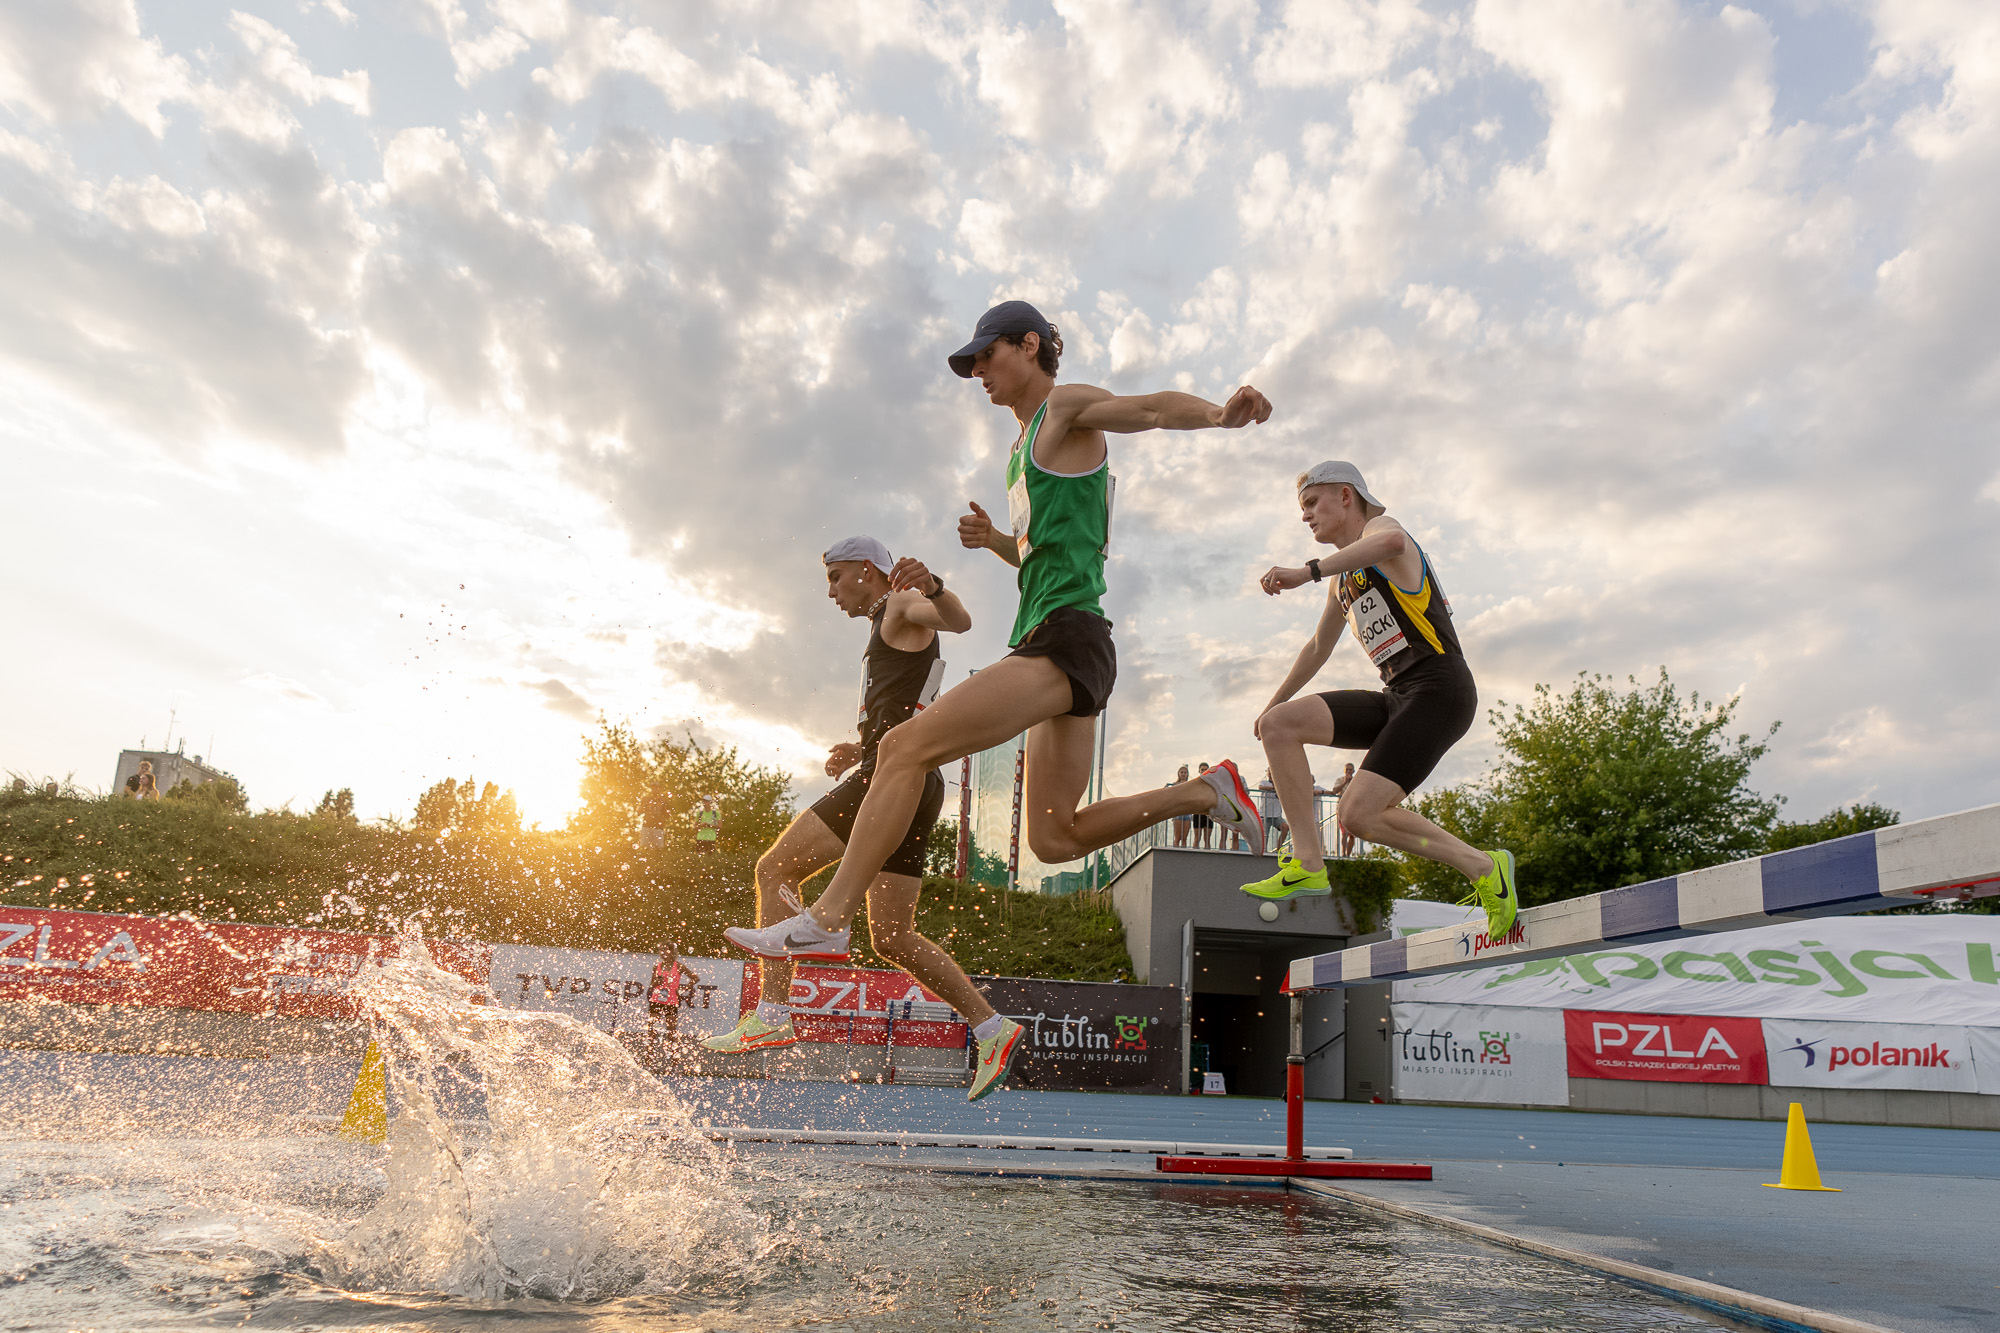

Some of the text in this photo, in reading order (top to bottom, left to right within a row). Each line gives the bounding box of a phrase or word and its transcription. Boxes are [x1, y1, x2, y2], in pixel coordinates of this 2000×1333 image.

[1360, 596, 1377, 614] 62
[1474, 920, 1526, 957] ponik
[516, 973, 718, 1009] TVP SPRT
[1592, 1022, 1739, 1059] PZLA
[1033, 1051, 1148, 1064] MIASTO INSPIRACJI
[1596, 1059, 1626, 1068] POLSKI
[1666, 1062, 1701, 1071] LEKKIEJ
[1702, 1063, 1741, 1071] ATLETYKI
[1828, 1041, 1951, 1072] polanik
[1402, 1066, 1512, 1077] MIASTO INSPIRACJI
[1210, 1081, 1220, 1089] 17
